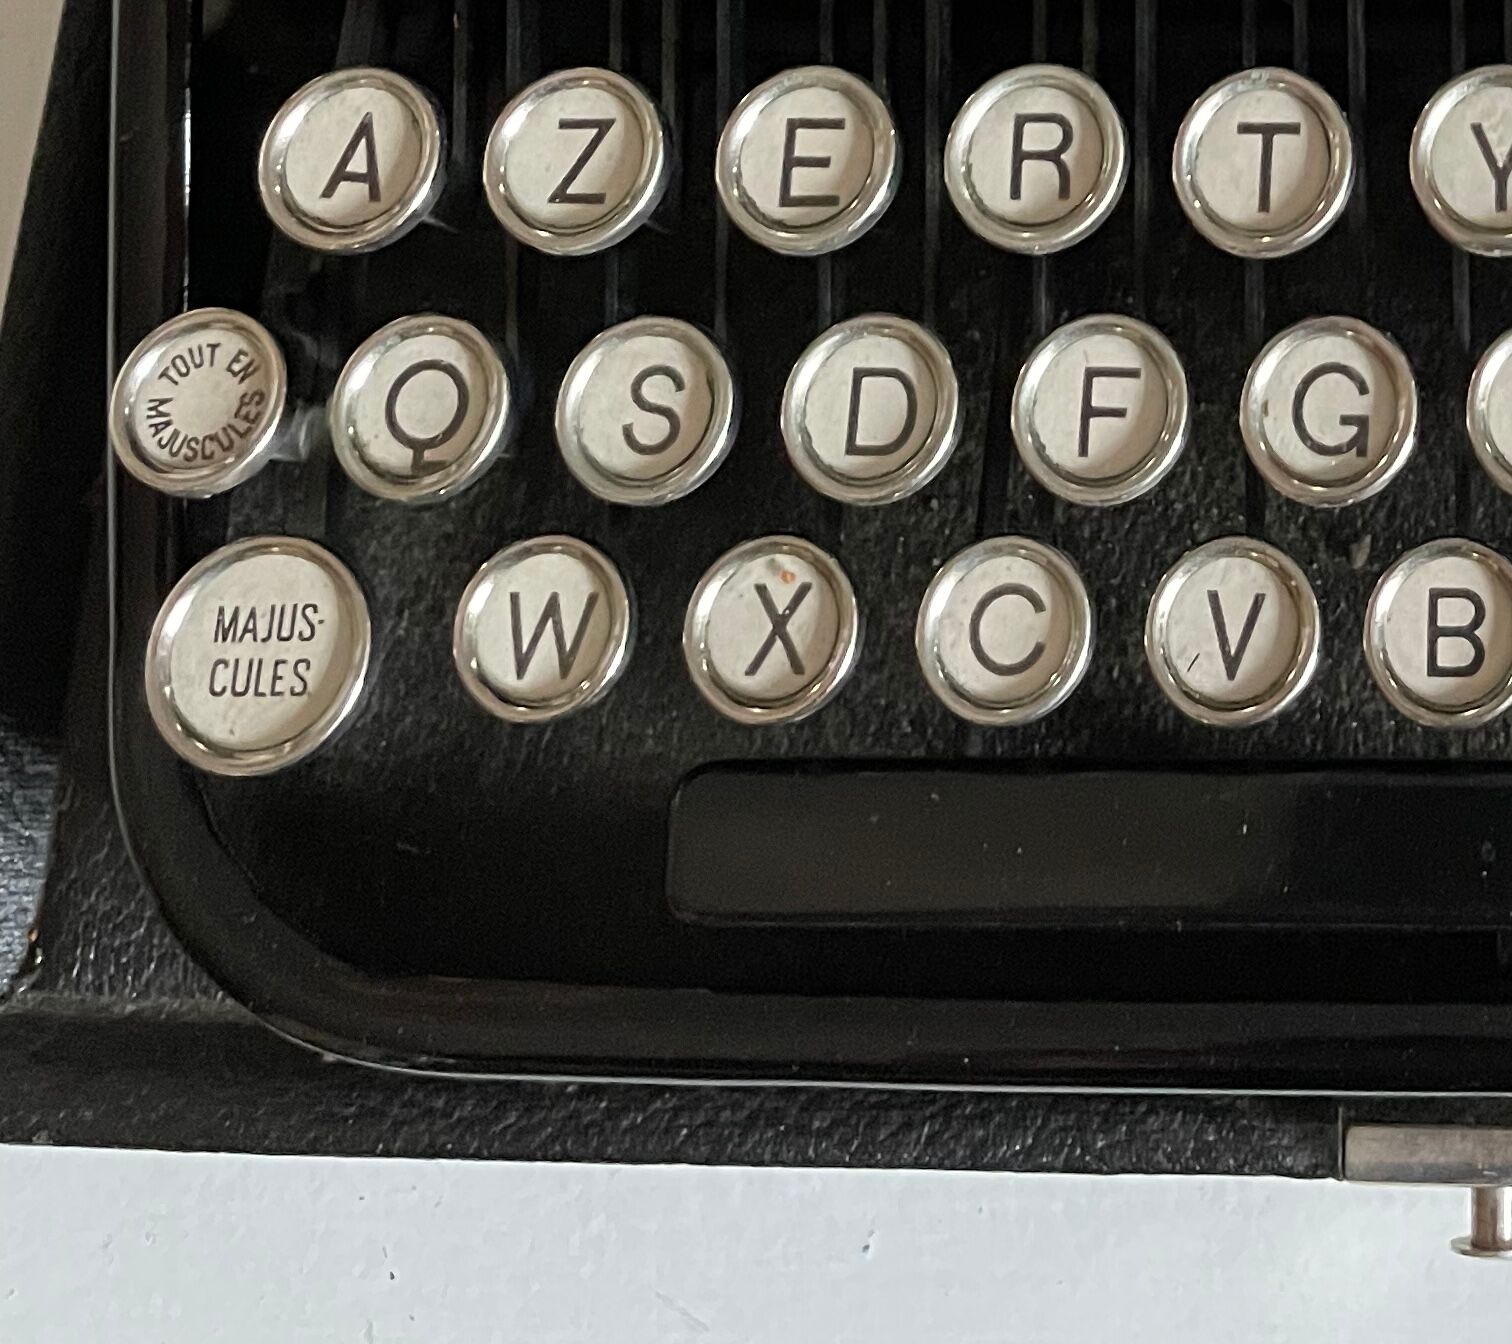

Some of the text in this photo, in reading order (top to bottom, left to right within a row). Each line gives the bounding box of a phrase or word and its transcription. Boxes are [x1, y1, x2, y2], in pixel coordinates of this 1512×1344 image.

[320, 112, 381, 203] A
[548, 119, 616, 205] Z
[779, 118, 845, 207] E
[1010, 113, 1073, 200] R
[1237, 123, 1300, 213] T
[158, 342, 261, 388] TOUT EN
[623, 365, 685, 455] S
[1292, 362, 1369, 458] G
[146, 388, 267, 464] MAJUSCULES
[385, 359, 470, 472] Q
[845, 367, 918, 456] D
[1078, 367, 1141, 457] F
[213, 603, 326, 645] MAJUS-
[510, 591, 599, 681] W
[745, 582, 812, 676] X
[969, 583, 1046, 676] C
[1207, 590, 1265, 681] V
[1427, 588, 1485, 677] B
[207, 657, 312, 699] CULES
